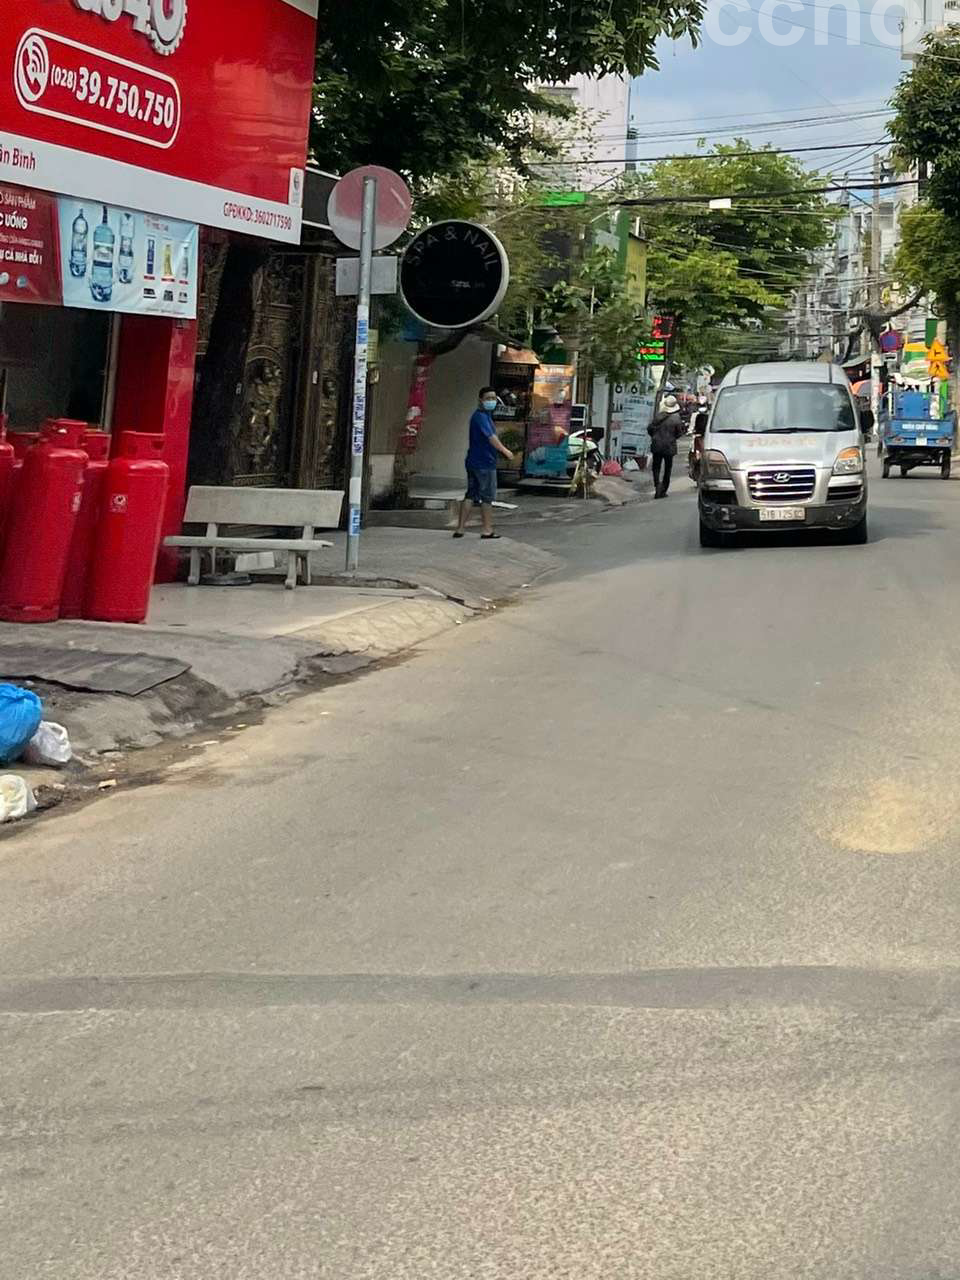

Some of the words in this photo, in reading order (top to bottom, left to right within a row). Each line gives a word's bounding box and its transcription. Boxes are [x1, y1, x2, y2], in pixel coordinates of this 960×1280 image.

[51, 64, 77, 93] (028)
[76, 66, 175, 129] 39.750.750
[406, 233, 440, 266] SPA
[444, 225, 458, 241] &
[463, 229, 498, 271] NAIL
